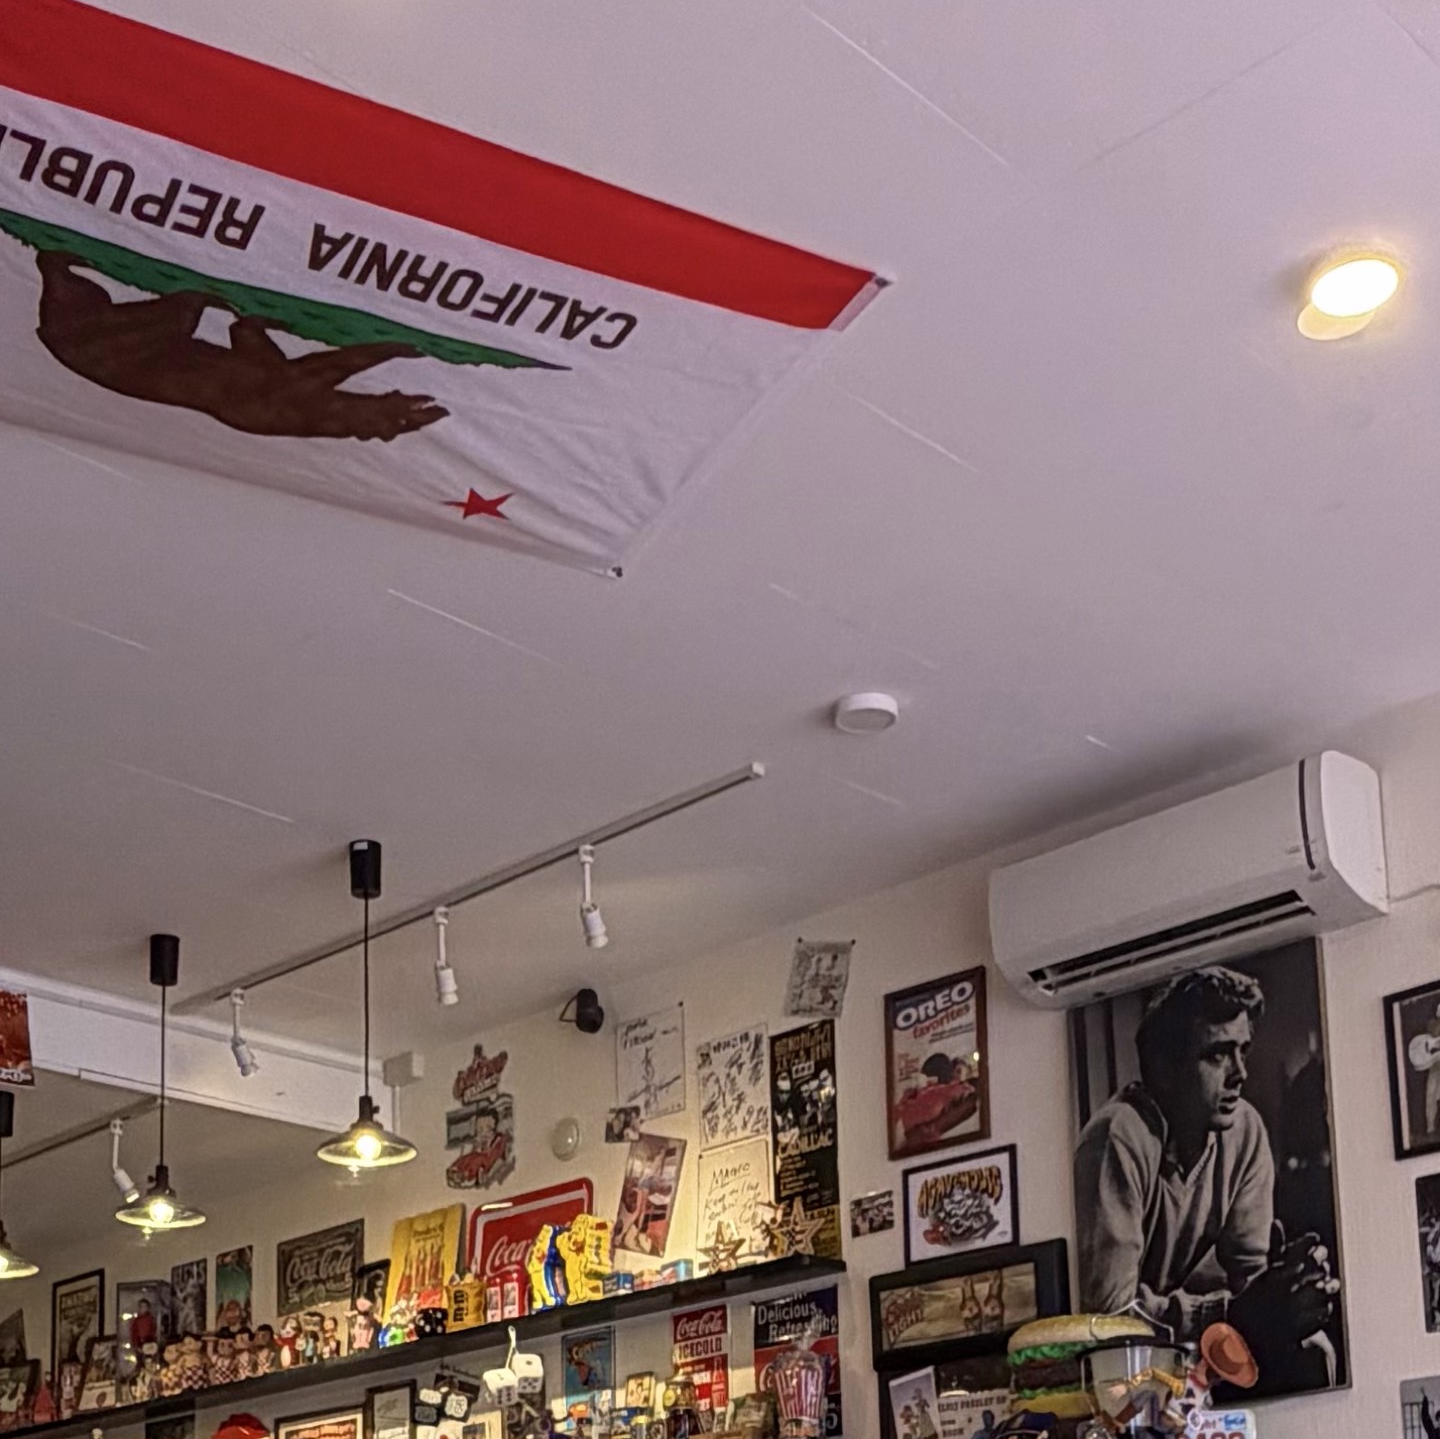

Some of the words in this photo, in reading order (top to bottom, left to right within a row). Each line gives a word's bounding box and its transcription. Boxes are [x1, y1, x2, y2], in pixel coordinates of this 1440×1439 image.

[306, 221, 640, 355] CALIFORNIA
[895, 980, 976, 1031] OREO
[912, 1004, 971, 1041] favorites
[676, 1310, 724, 1341] Coca-Cola
